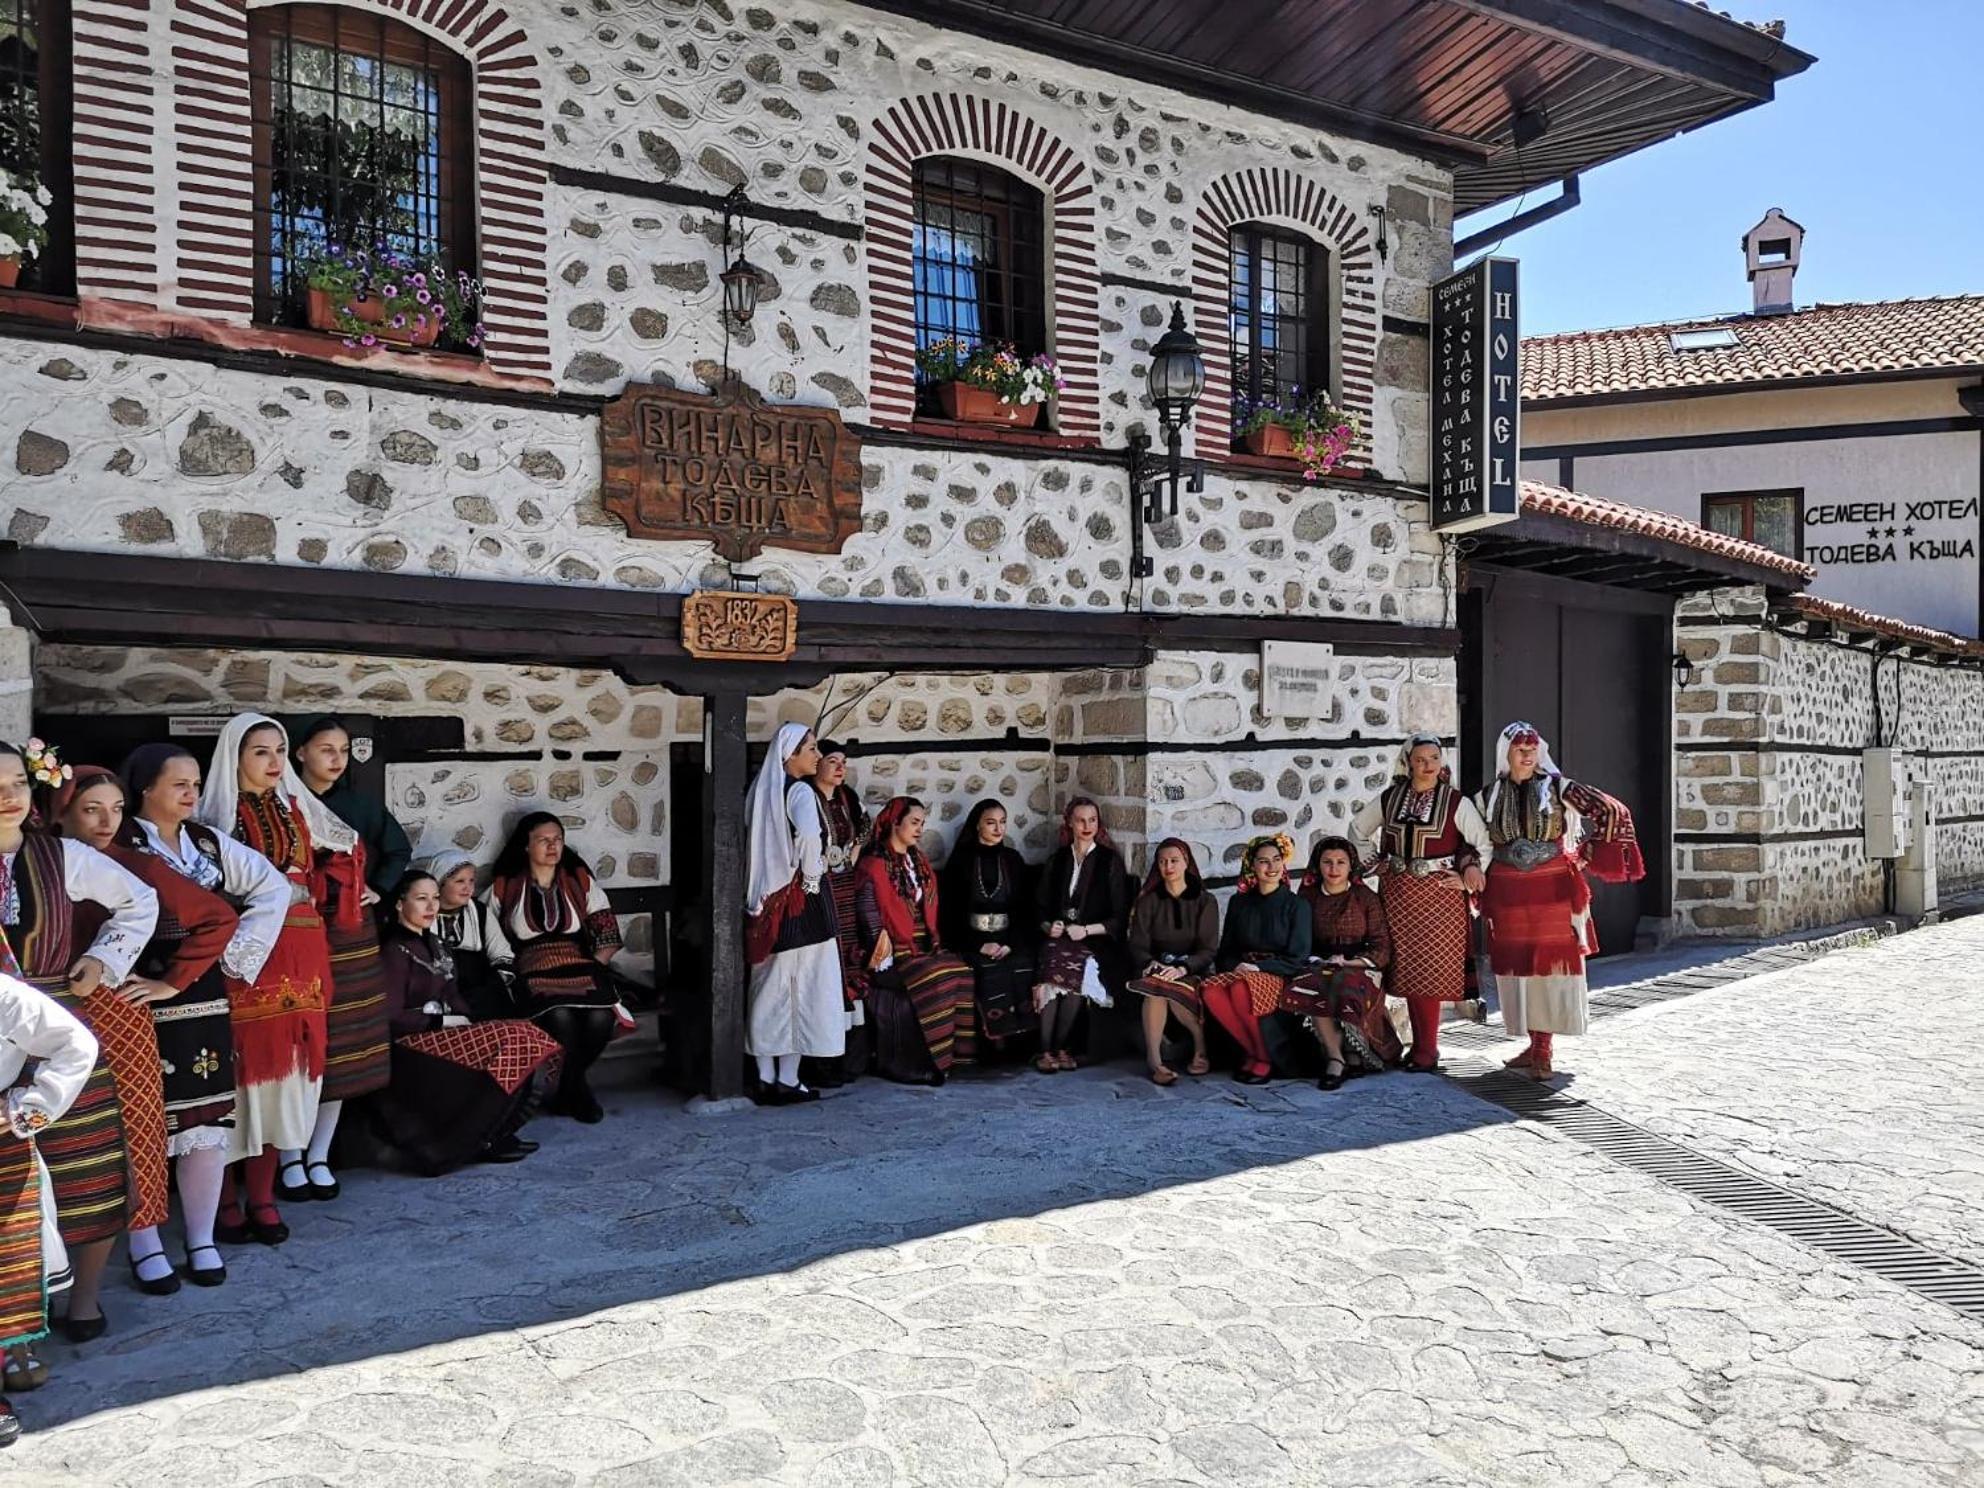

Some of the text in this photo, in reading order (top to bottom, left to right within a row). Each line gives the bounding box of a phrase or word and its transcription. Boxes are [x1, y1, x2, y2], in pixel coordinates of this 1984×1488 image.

[1459, 307, 1477, 513] ТОДЕВА КЪЩА
[1493, 292, 1511, 485] HOTEL
[643, 404, 826, 466] ВИНАРНА
[1441, 325, 1454, 513] ХОТЕЛ МЕХАНА
[656, 453, 819, 500] ТОДЕВА
[1805, 497, 1979, 526] СЕМЕЕН ХОТЕЛ
[1805, 539, 1975, 565] ТОДЕВА КЪЩА
[725, 599, 759, 624] 1832
